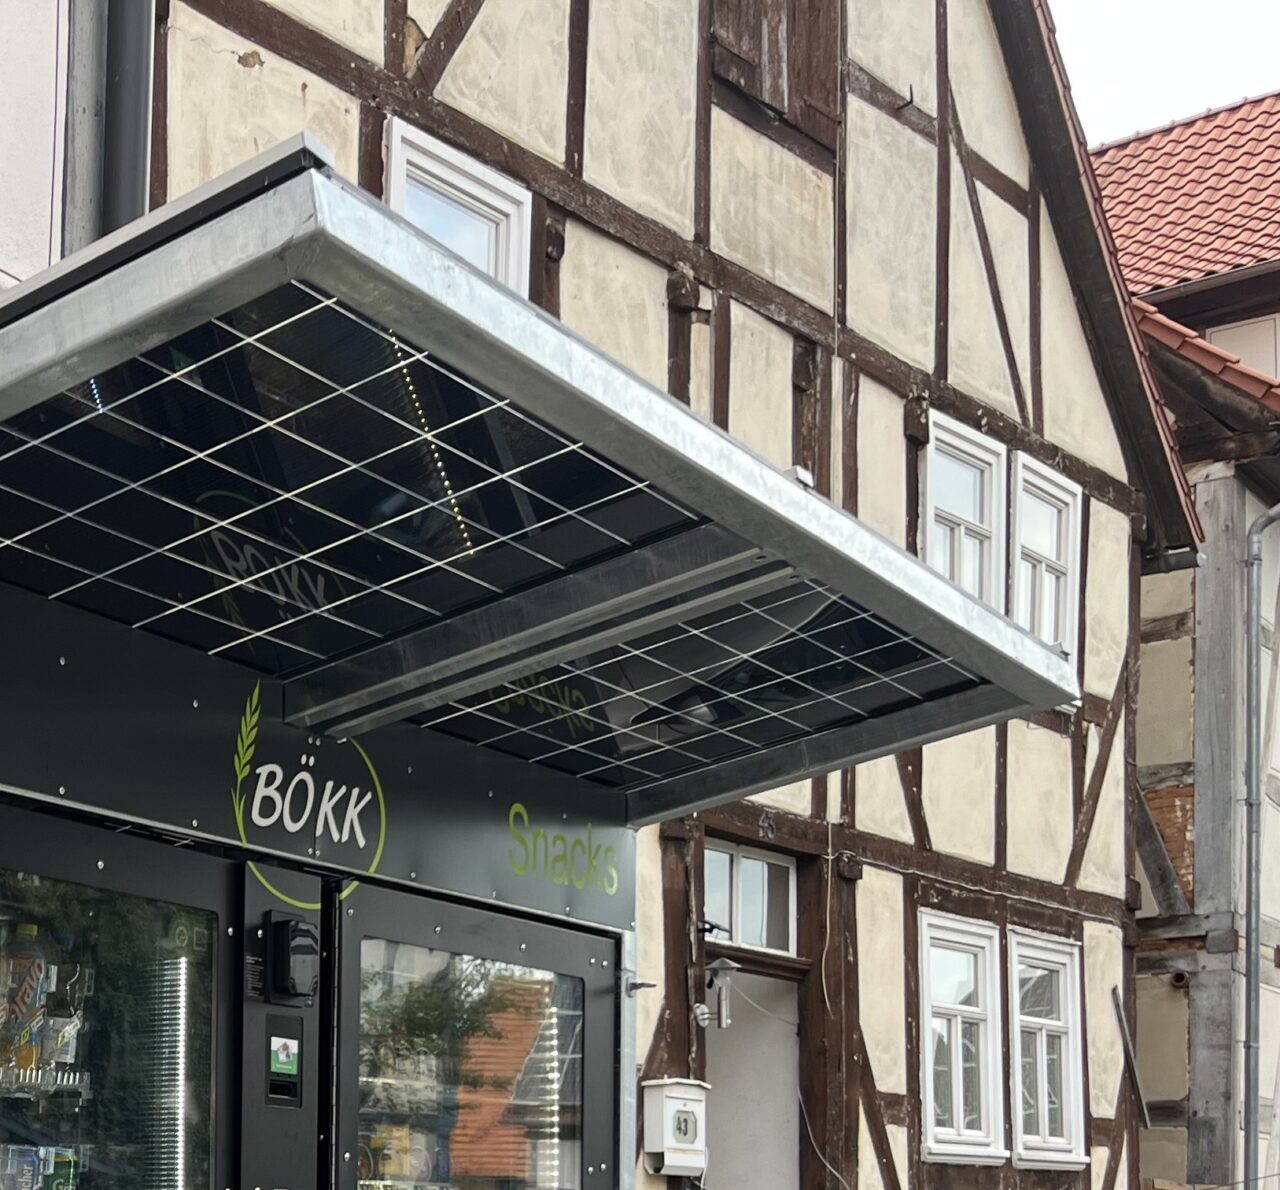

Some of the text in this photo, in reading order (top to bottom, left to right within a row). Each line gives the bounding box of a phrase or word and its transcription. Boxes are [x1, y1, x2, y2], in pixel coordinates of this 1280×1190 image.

[251, 754, 372, 849] BÖKK
[508, 803, 618, 896] Snacks
[675, 1115, 689, 1137] 43
